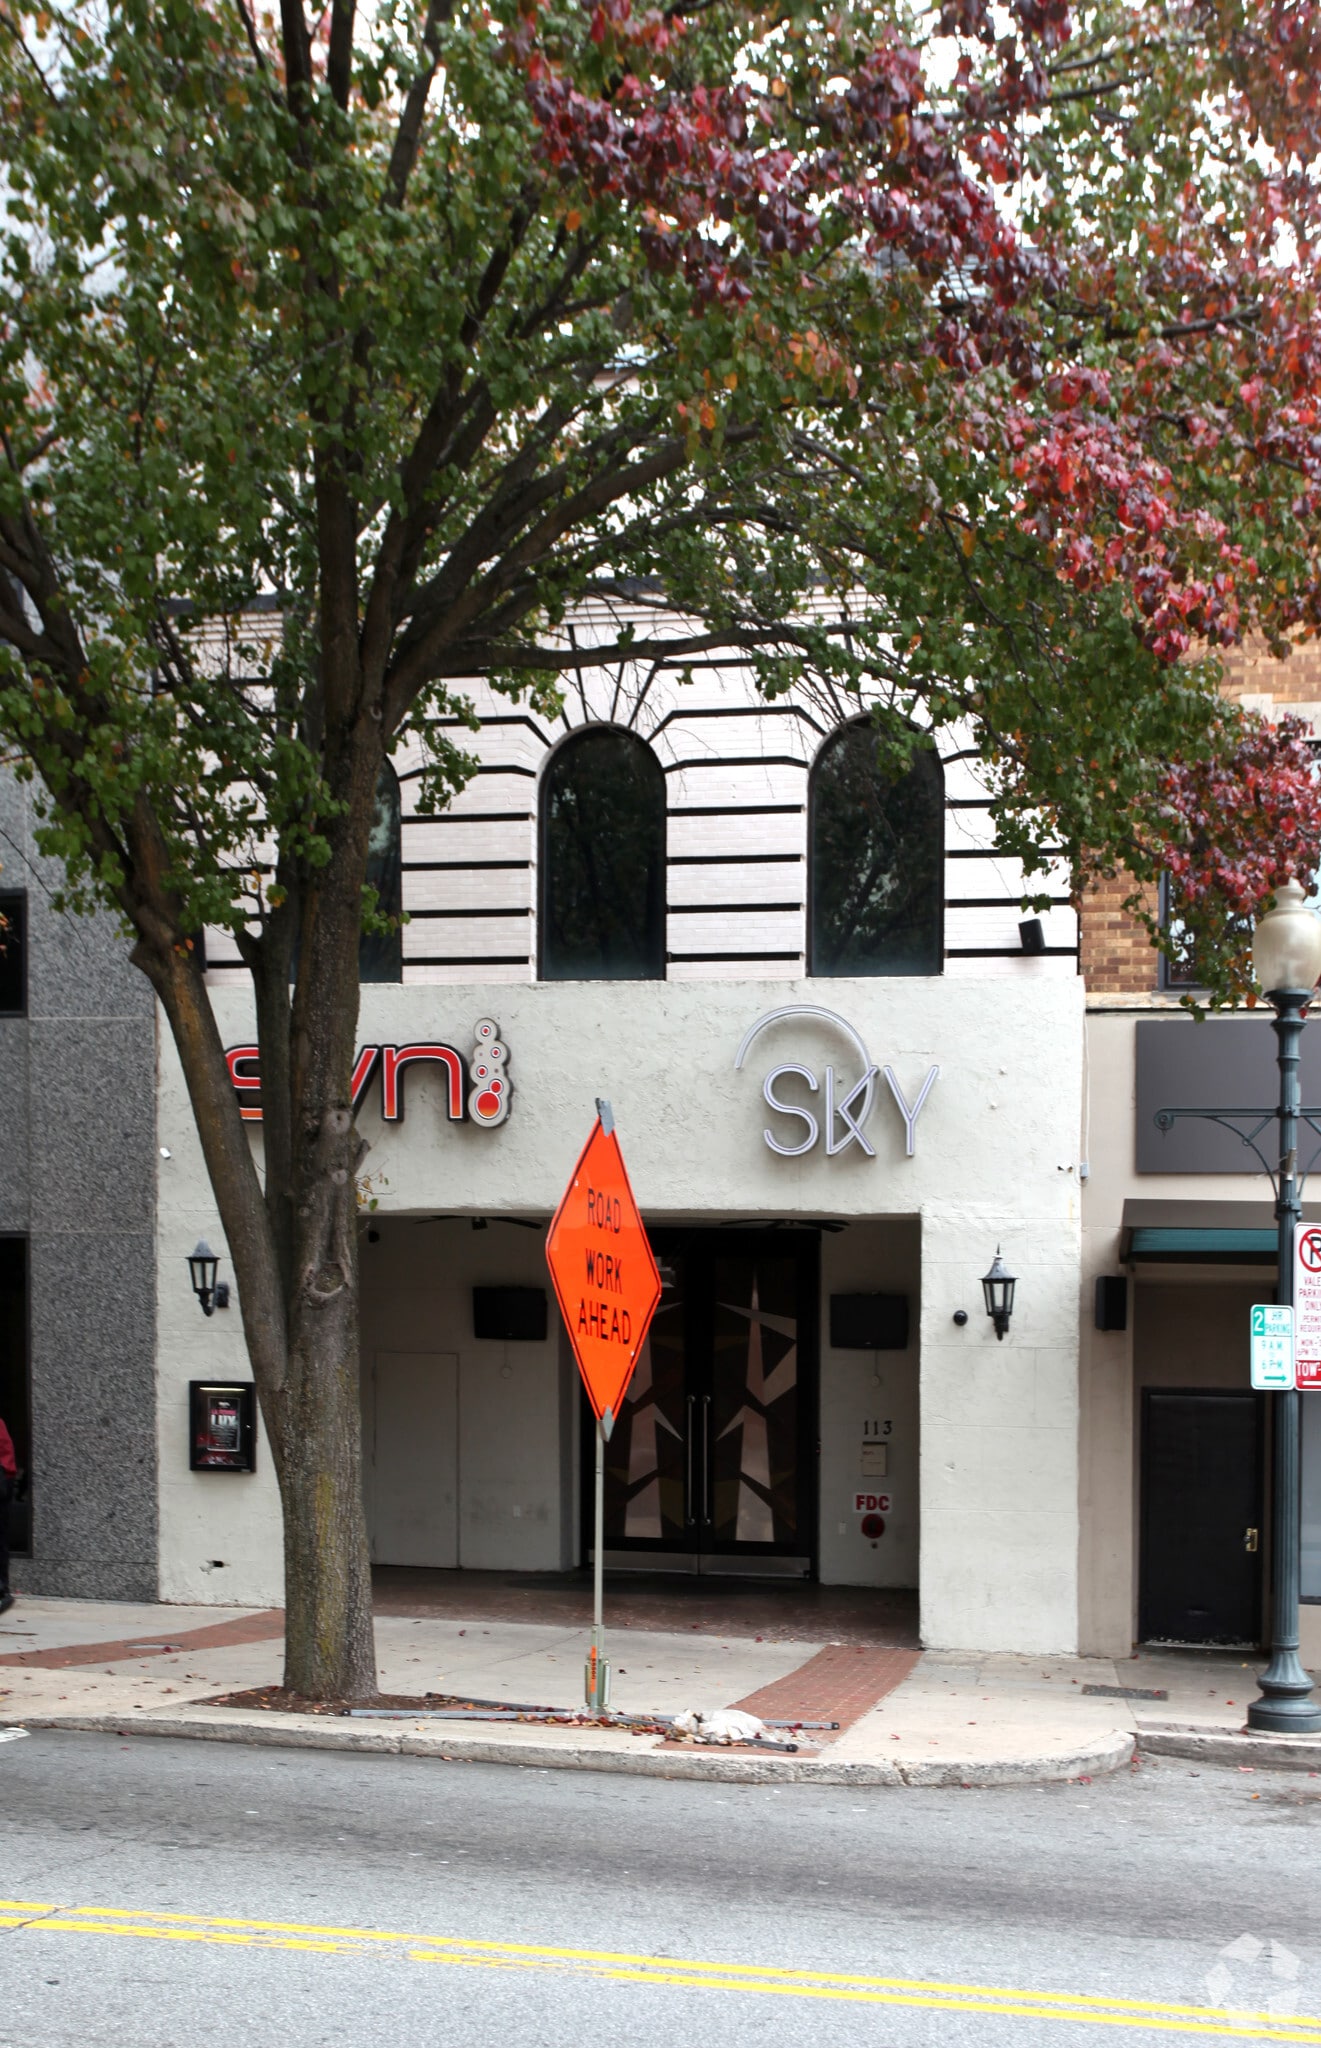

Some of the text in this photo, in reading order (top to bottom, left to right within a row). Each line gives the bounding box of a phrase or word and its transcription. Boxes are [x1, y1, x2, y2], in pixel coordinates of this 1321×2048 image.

[224, 1043, 466, 1123] sn
[763, 1063, 940, 1156] SKY
[587, 1188, 621, 1233] ROAD
[586, 1248, 622, 1294] WORK
[578, 1298, 632, 1345] AHEAD
[1254, 1312, 1264, 1332] 2
[1265, 1322, 1291, 1334] PARKING
[863, 1420, 893, 1436] 113
[856, 1495, 890, 1511] FDC
